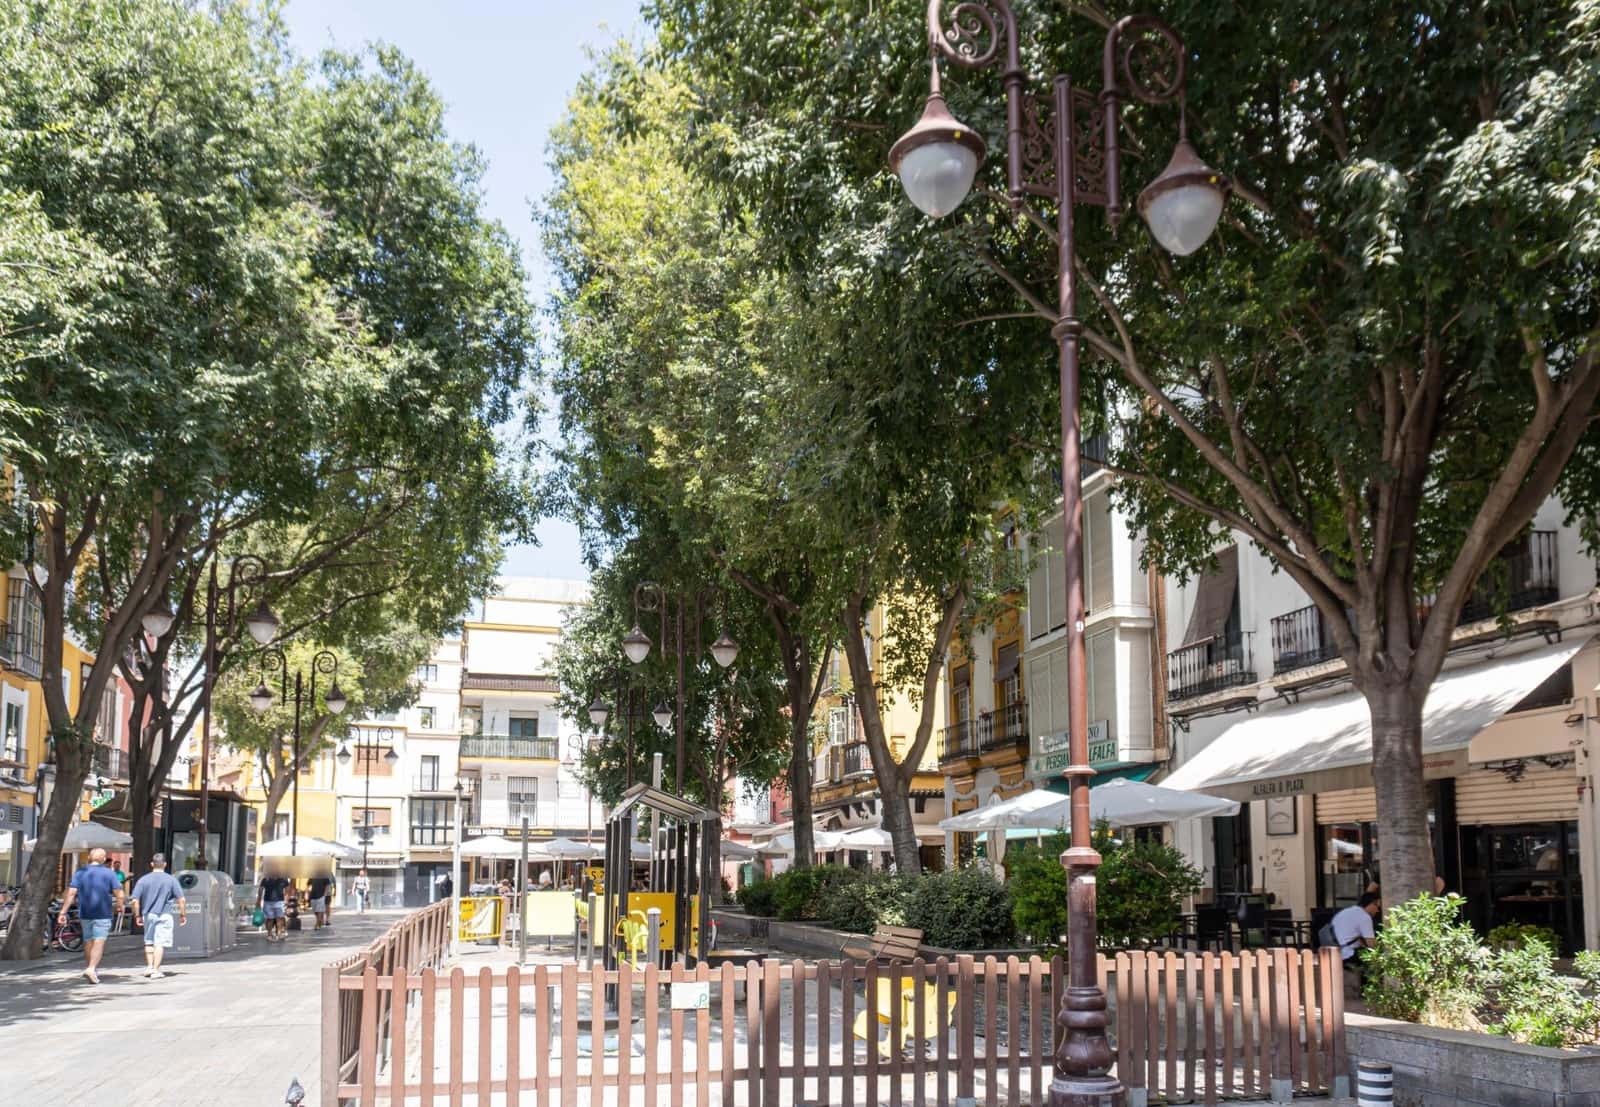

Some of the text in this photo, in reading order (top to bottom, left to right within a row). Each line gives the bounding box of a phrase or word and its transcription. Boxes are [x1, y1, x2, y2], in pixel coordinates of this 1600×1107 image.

[1088, 742, 1116, 762] LFALFA
[1253, 783, 1275, 795] ALFALFA
[1286, 779, 1304, 792] PLAZA
